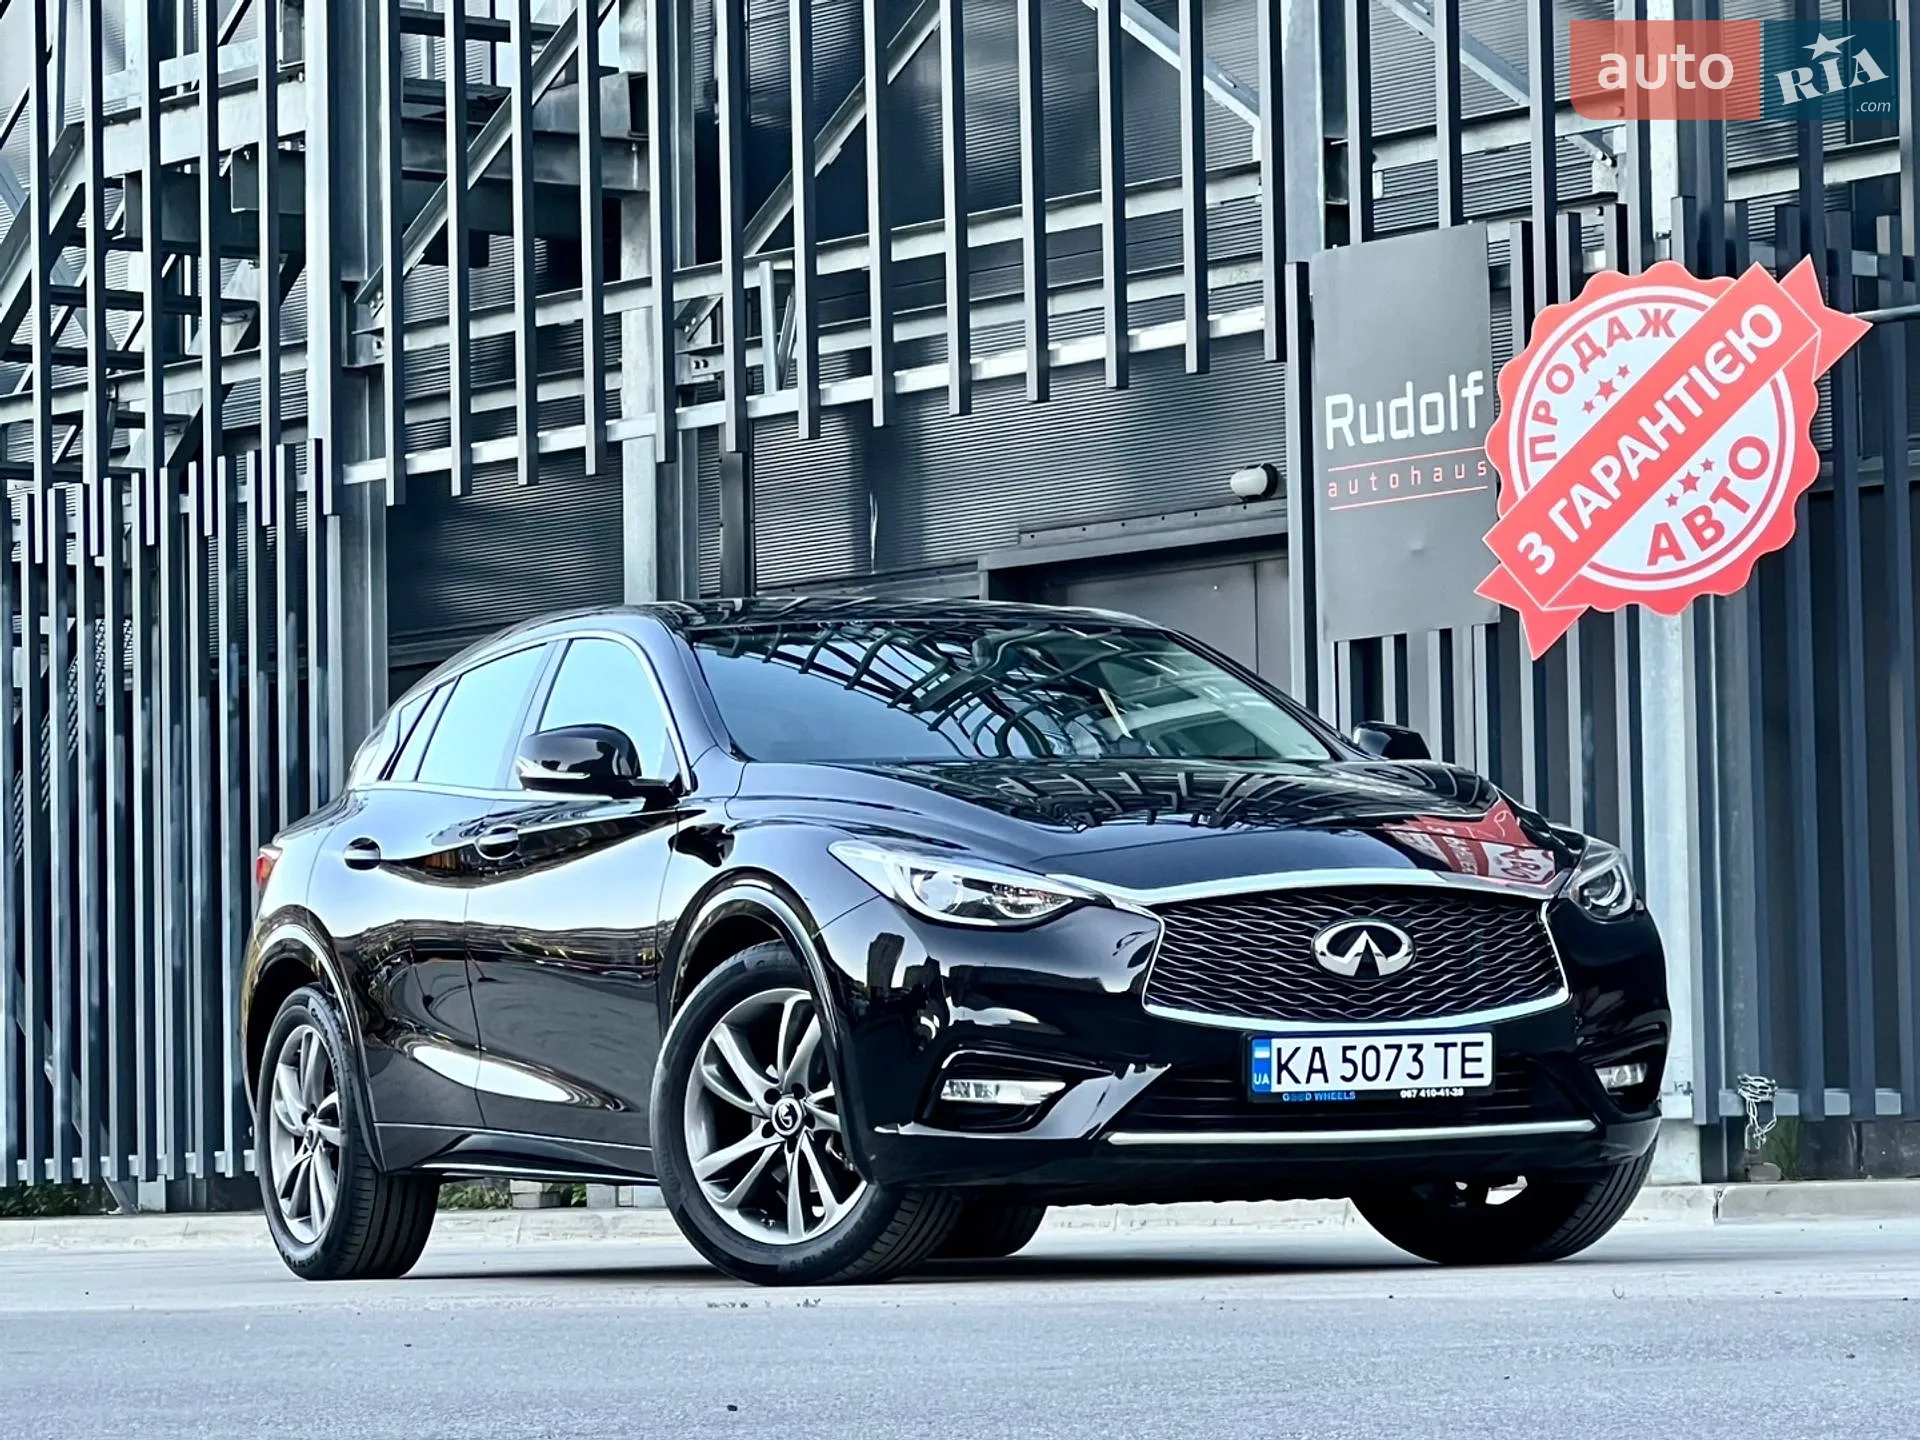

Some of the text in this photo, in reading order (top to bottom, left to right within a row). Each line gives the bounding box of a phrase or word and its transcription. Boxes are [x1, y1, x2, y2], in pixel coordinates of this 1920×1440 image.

[1325, 370, 1484, 450] Rudolf
[1529, 308, 1677, 463] ПРОДАЖ
[1547, 303, 1783, 543] ГАРАНТІЄЮ
[1328, 460, 1487, 498] autohaus
[1645, 435, 1771, 567] АВТО
[1253, 1072, 1270, 1086] UA
[1276, 1041, 1485, 1085] KA 5073 TE
